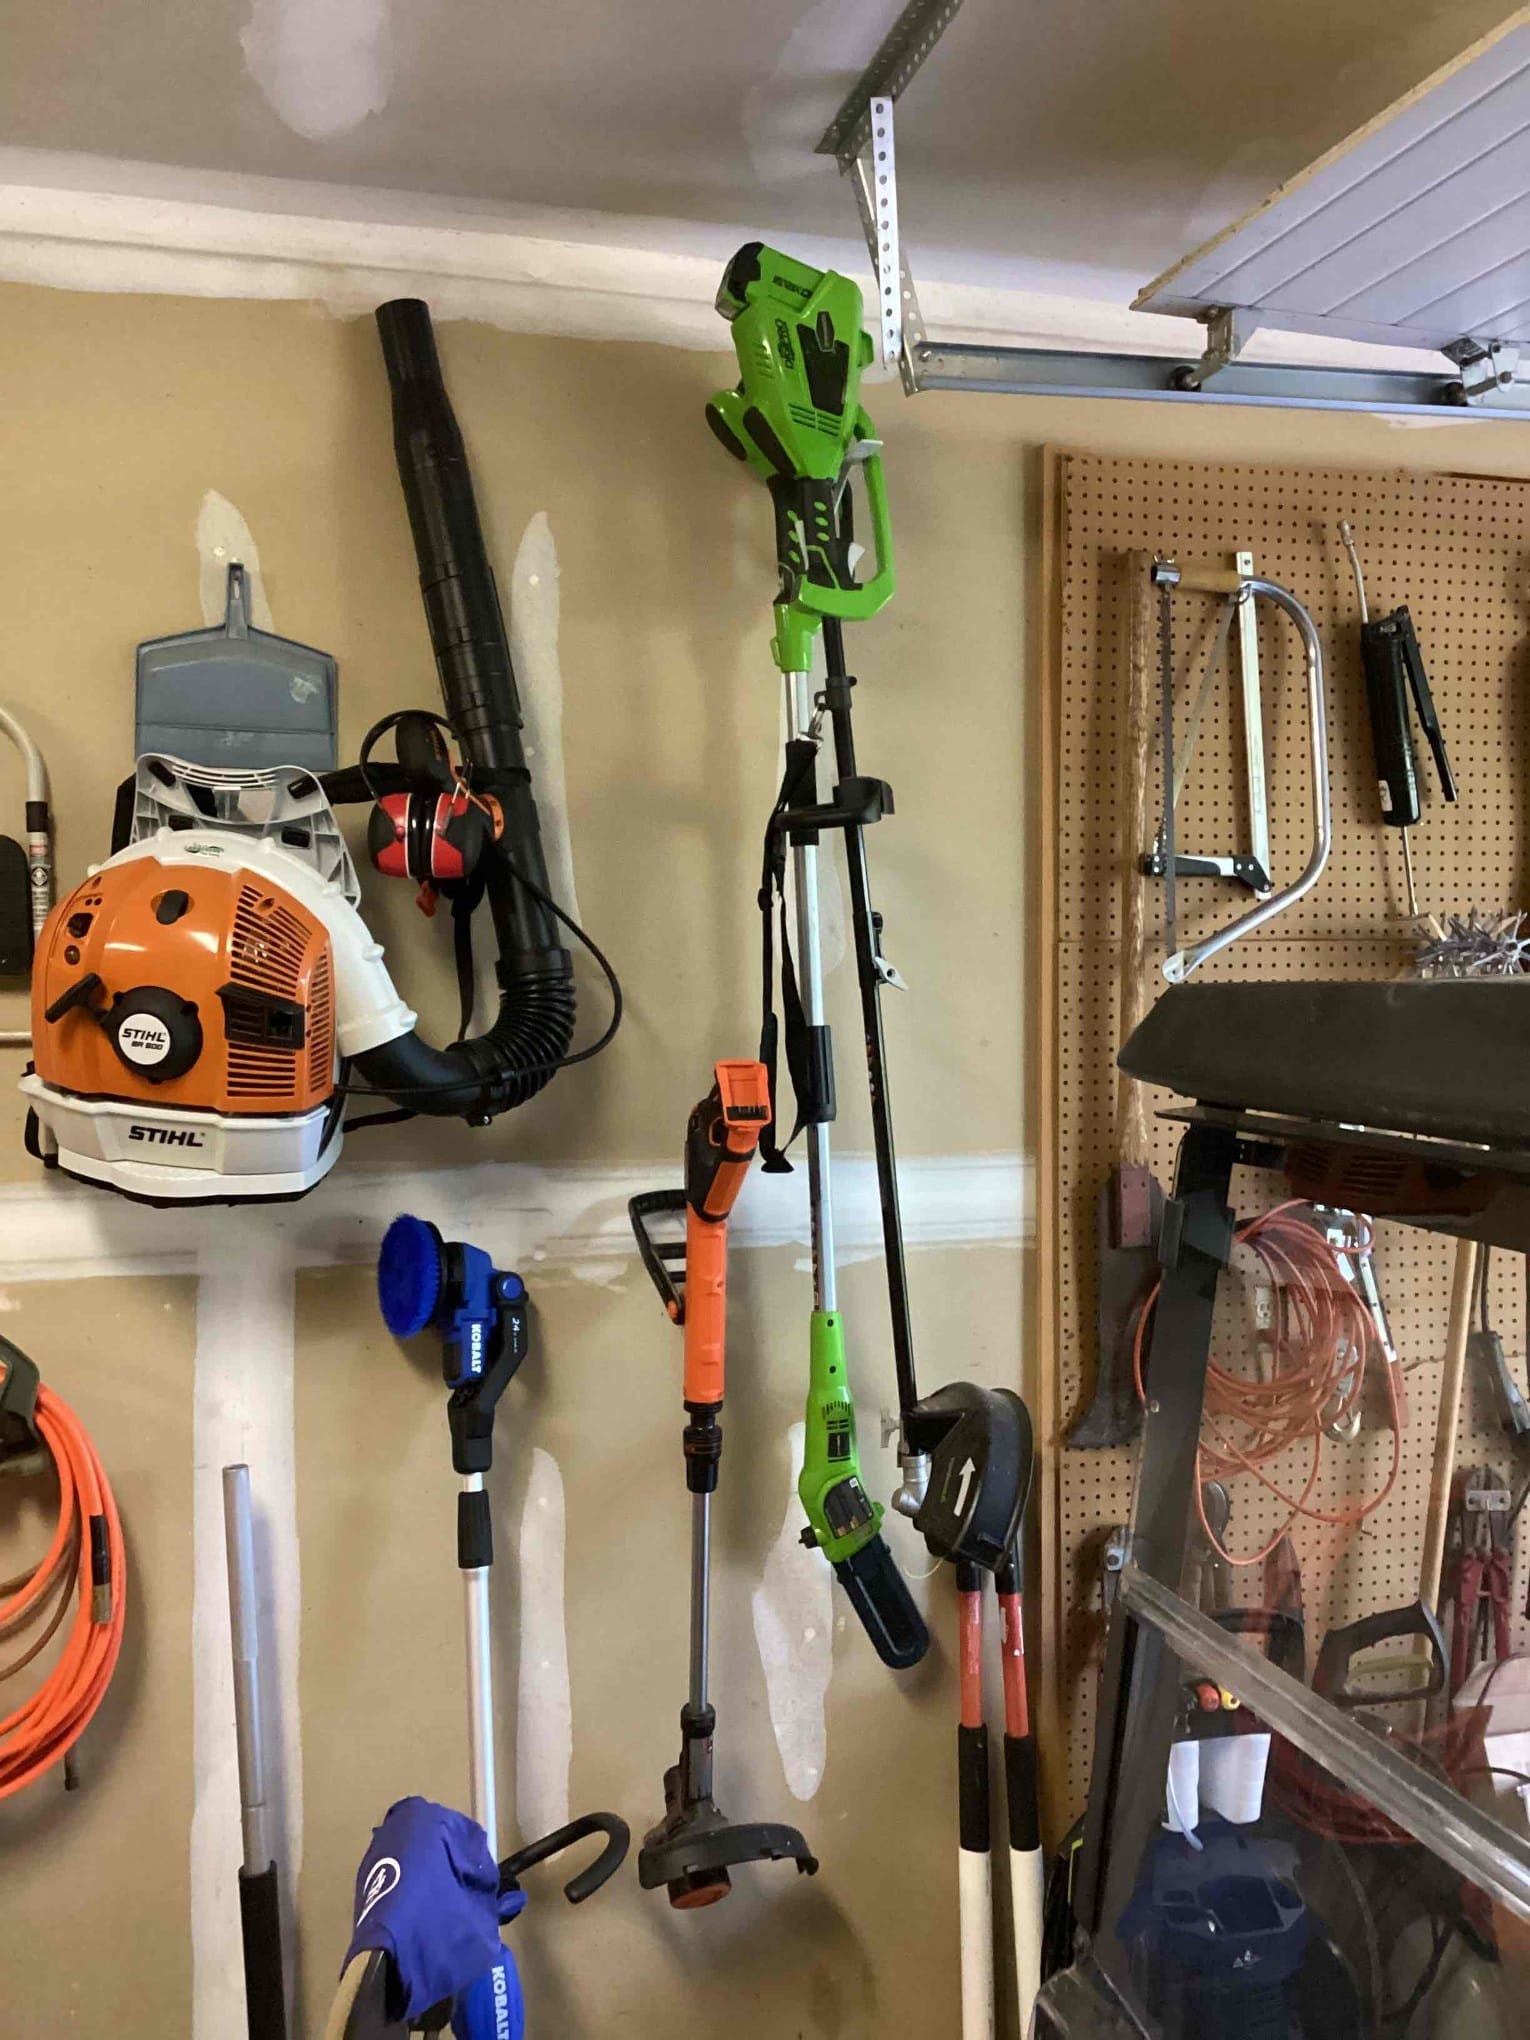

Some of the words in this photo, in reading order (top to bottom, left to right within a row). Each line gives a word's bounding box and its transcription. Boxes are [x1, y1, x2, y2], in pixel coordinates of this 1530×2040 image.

[121, 1028, 166, 1043] STIHL
[128, 1125, 204, 1147] STIHL
[471, 1324, 482, 1374] KOBALT
